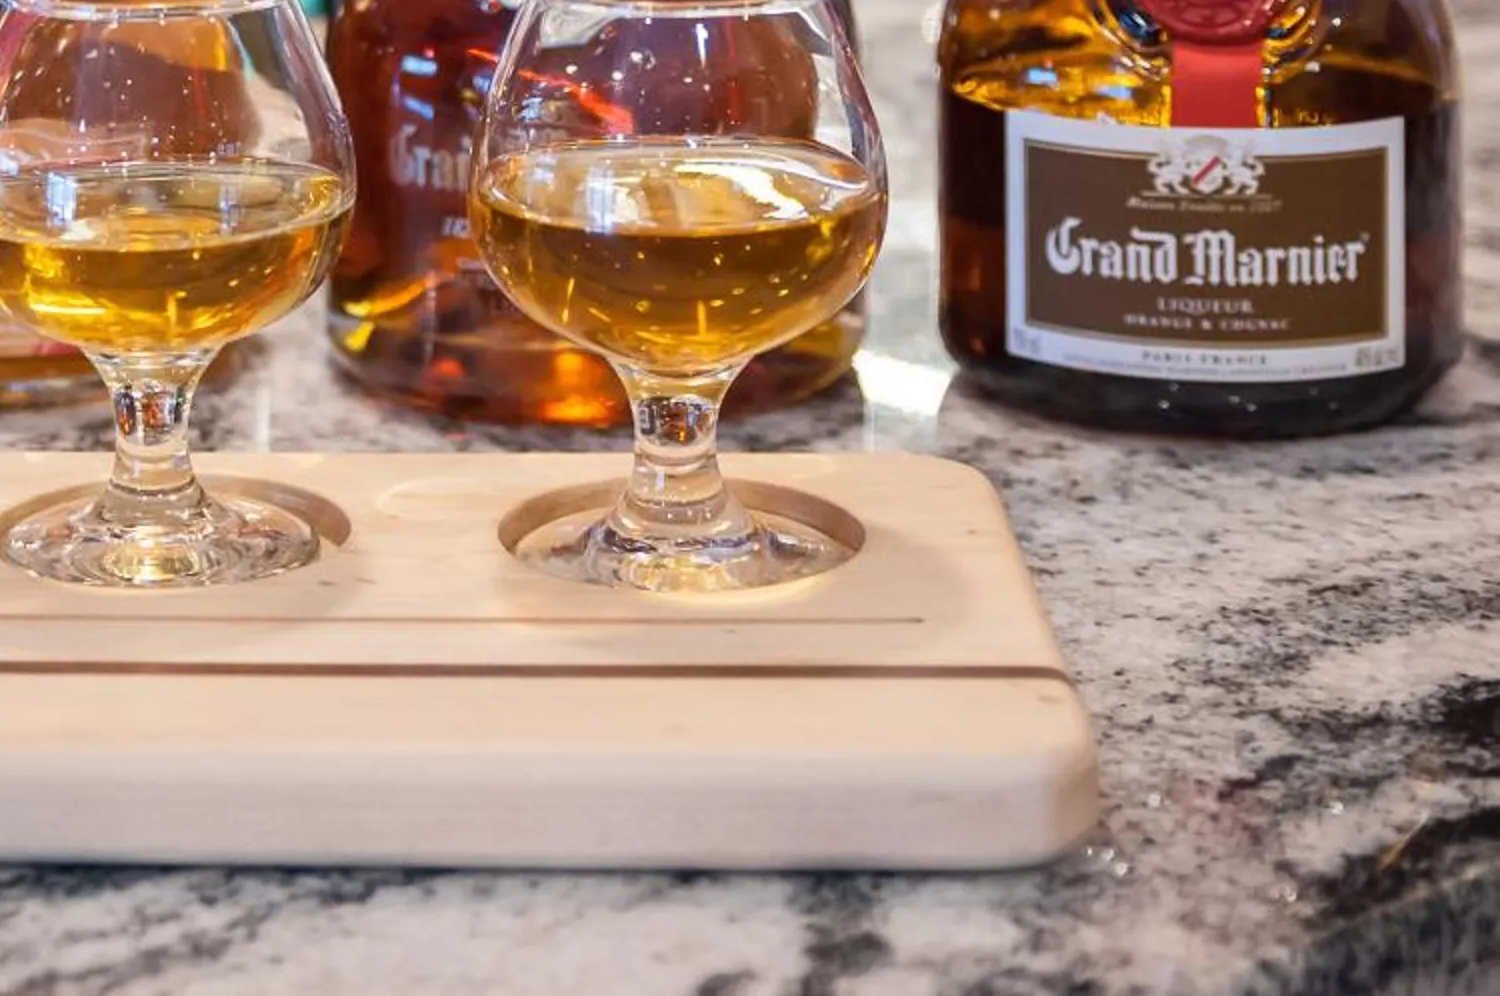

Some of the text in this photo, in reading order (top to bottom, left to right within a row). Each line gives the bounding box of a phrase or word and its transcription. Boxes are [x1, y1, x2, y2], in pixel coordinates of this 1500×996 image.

[1046, 216, 1366, 288] Grand Marnier
[1156, 297, 1255, 316] LIQUEUR
